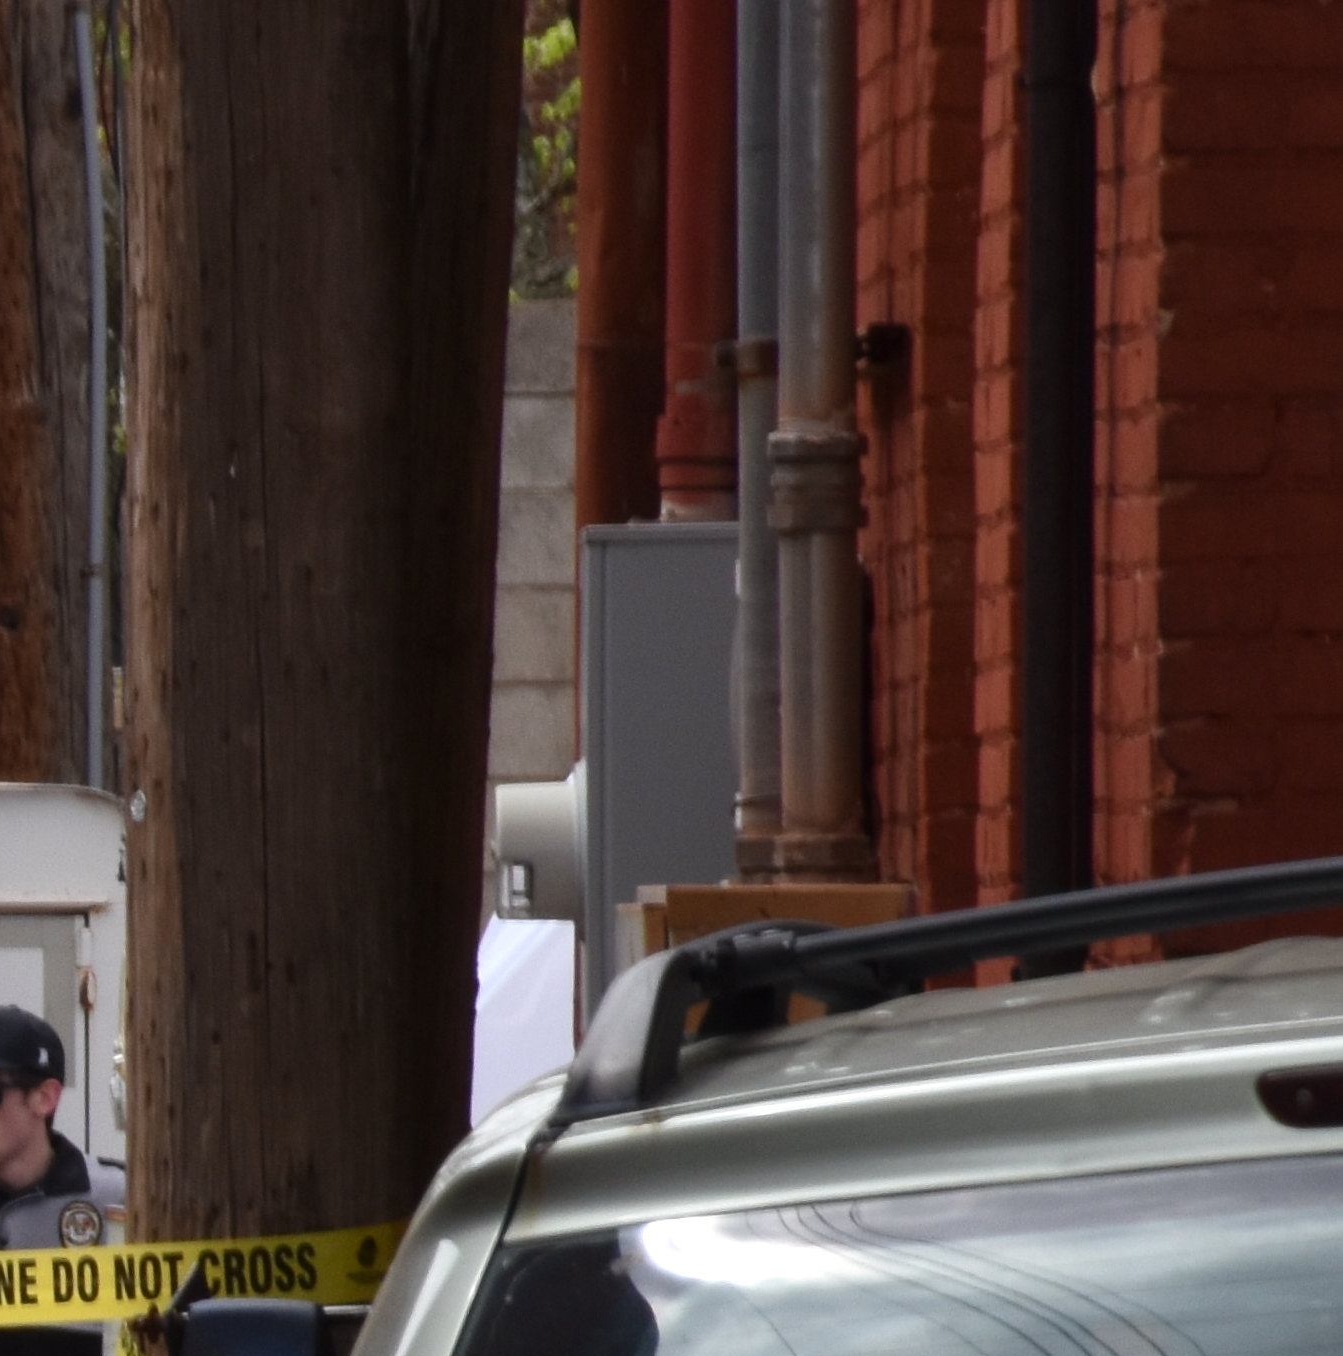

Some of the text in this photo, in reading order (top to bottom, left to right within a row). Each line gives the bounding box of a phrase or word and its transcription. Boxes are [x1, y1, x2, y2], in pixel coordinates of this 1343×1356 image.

[51, 1254, 100, 1304] DO
[115, 1251, 183, 1302] NOT
[198, 1242, 317, 1295] CROSS
